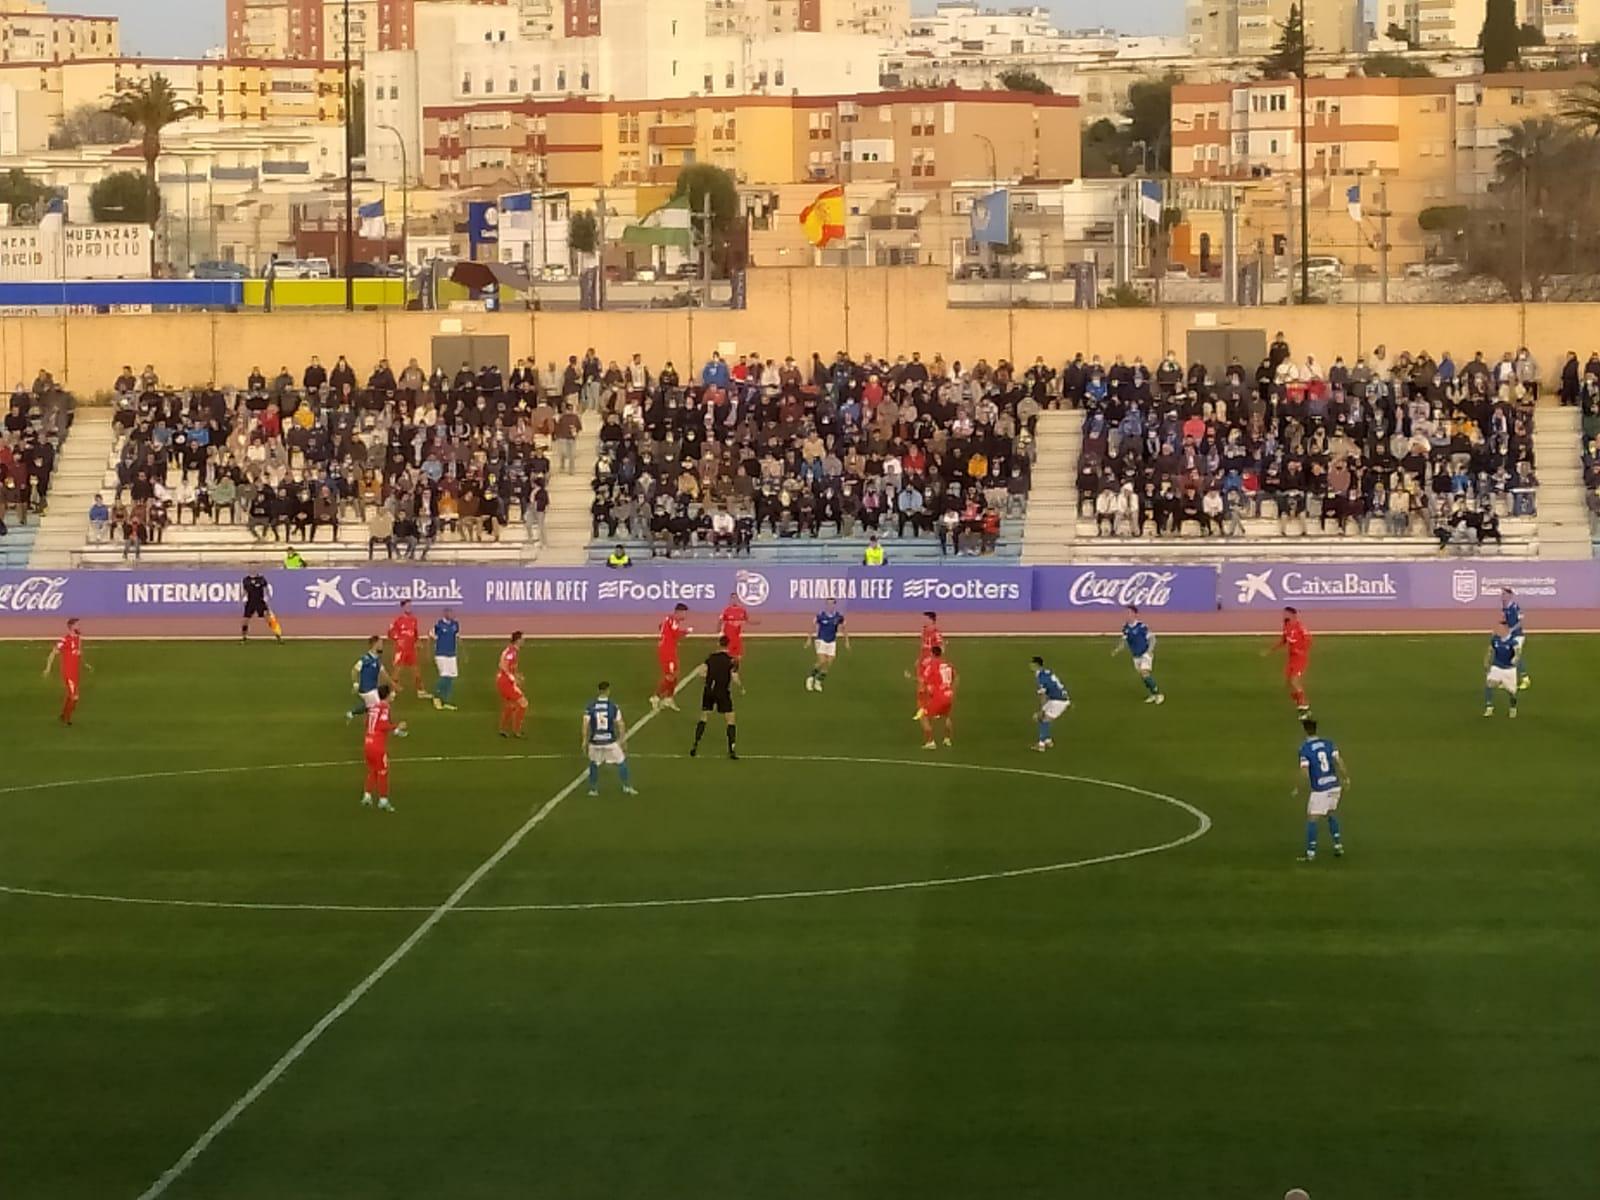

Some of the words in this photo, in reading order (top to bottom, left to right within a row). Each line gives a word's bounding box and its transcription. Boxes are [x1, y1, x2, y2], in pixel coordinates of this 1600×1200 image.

[127, 583, 273, 603] INTERMON
[351, 577, 464, 599] CaixaBank
[485, 580, 552, 602] PRIMERA
[619, 579, 706, 600] Footters
[789, 579, 857, 599] PRIMERA
[924, 578, 1020, 599] Footters
[1069, 571, 1178, 606] Coca-Cola
[1281, 571, 1397, 595] CaixaBank
[596, 711, 609, 730] 15
